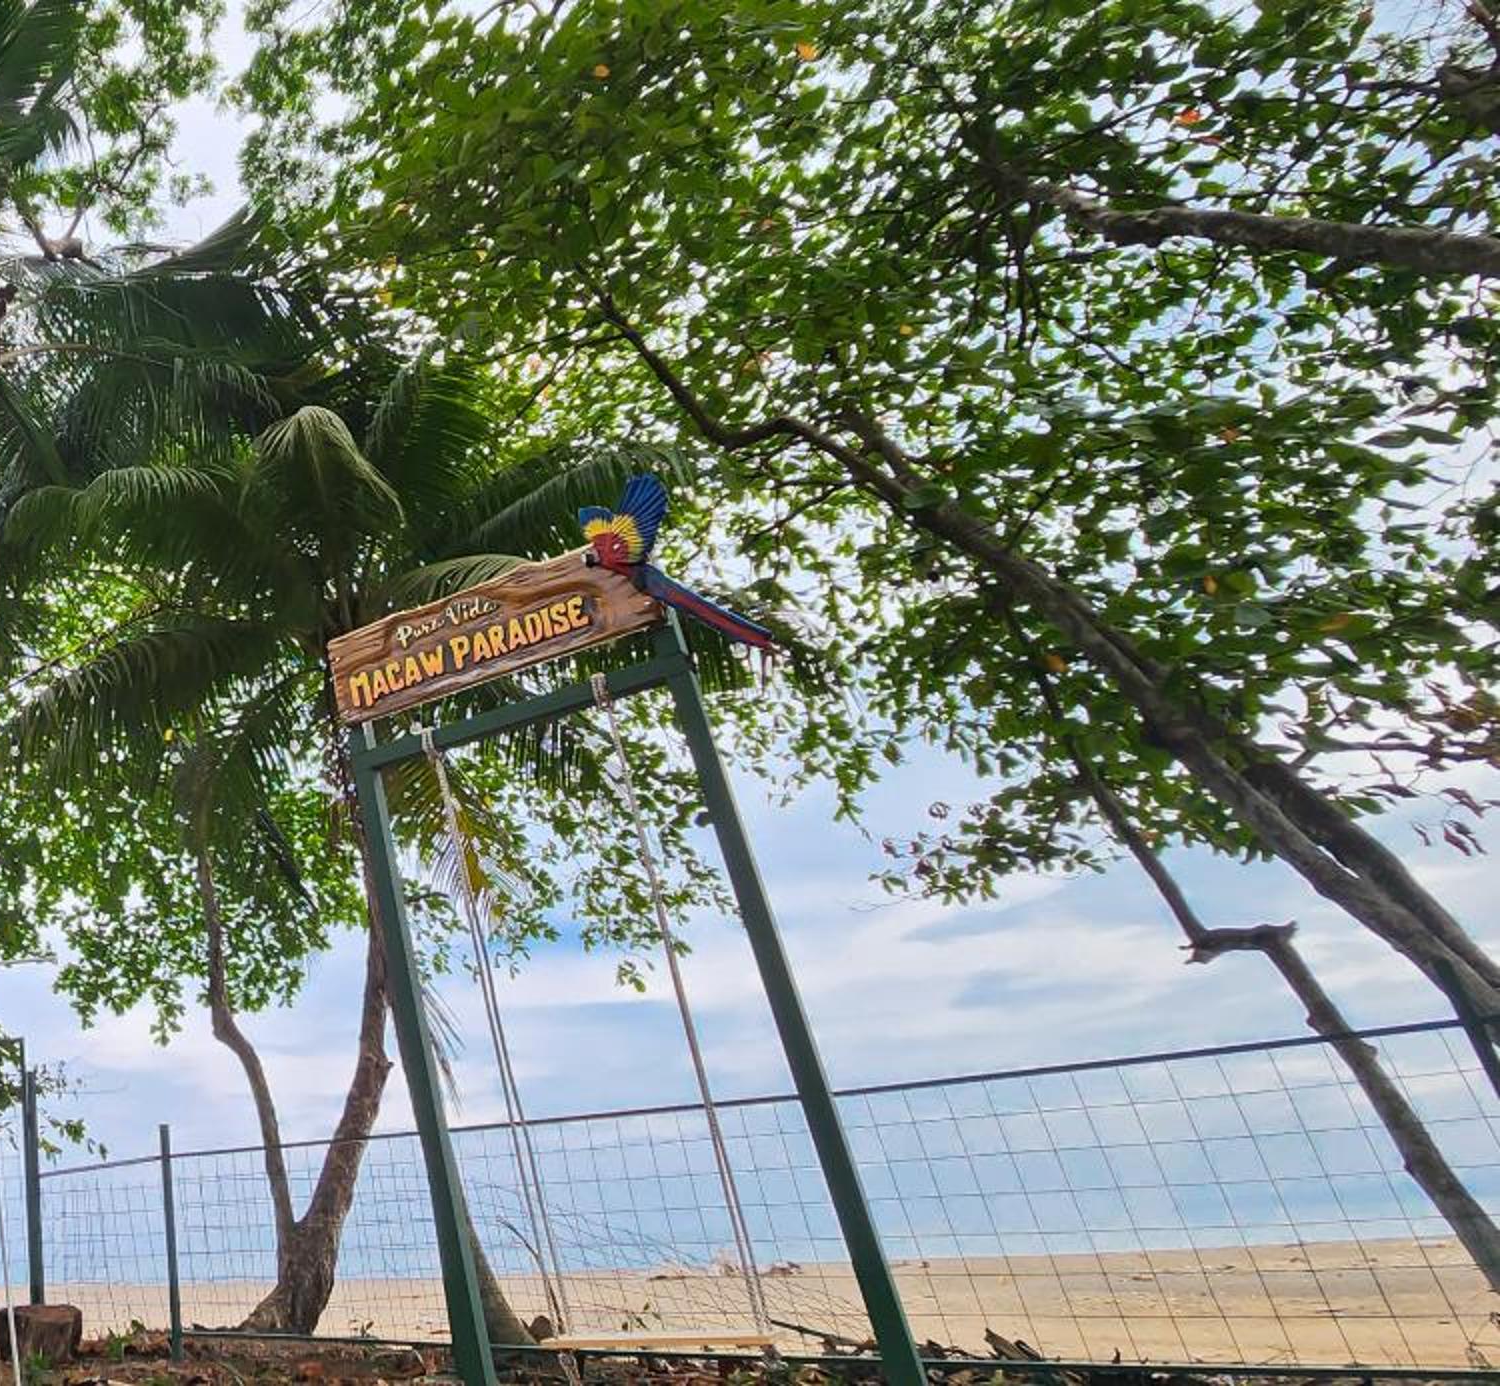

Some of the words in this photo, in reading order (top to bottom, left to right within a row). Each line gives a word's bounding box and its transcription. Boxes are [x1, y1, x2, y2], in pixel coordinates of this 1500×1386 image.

[349, 645, 444, 708] MACAW
[449, 594, 590, 671] PARADISE
[396, 618, 445, 648] Pura
[445, 597, 497, 625] Vida
